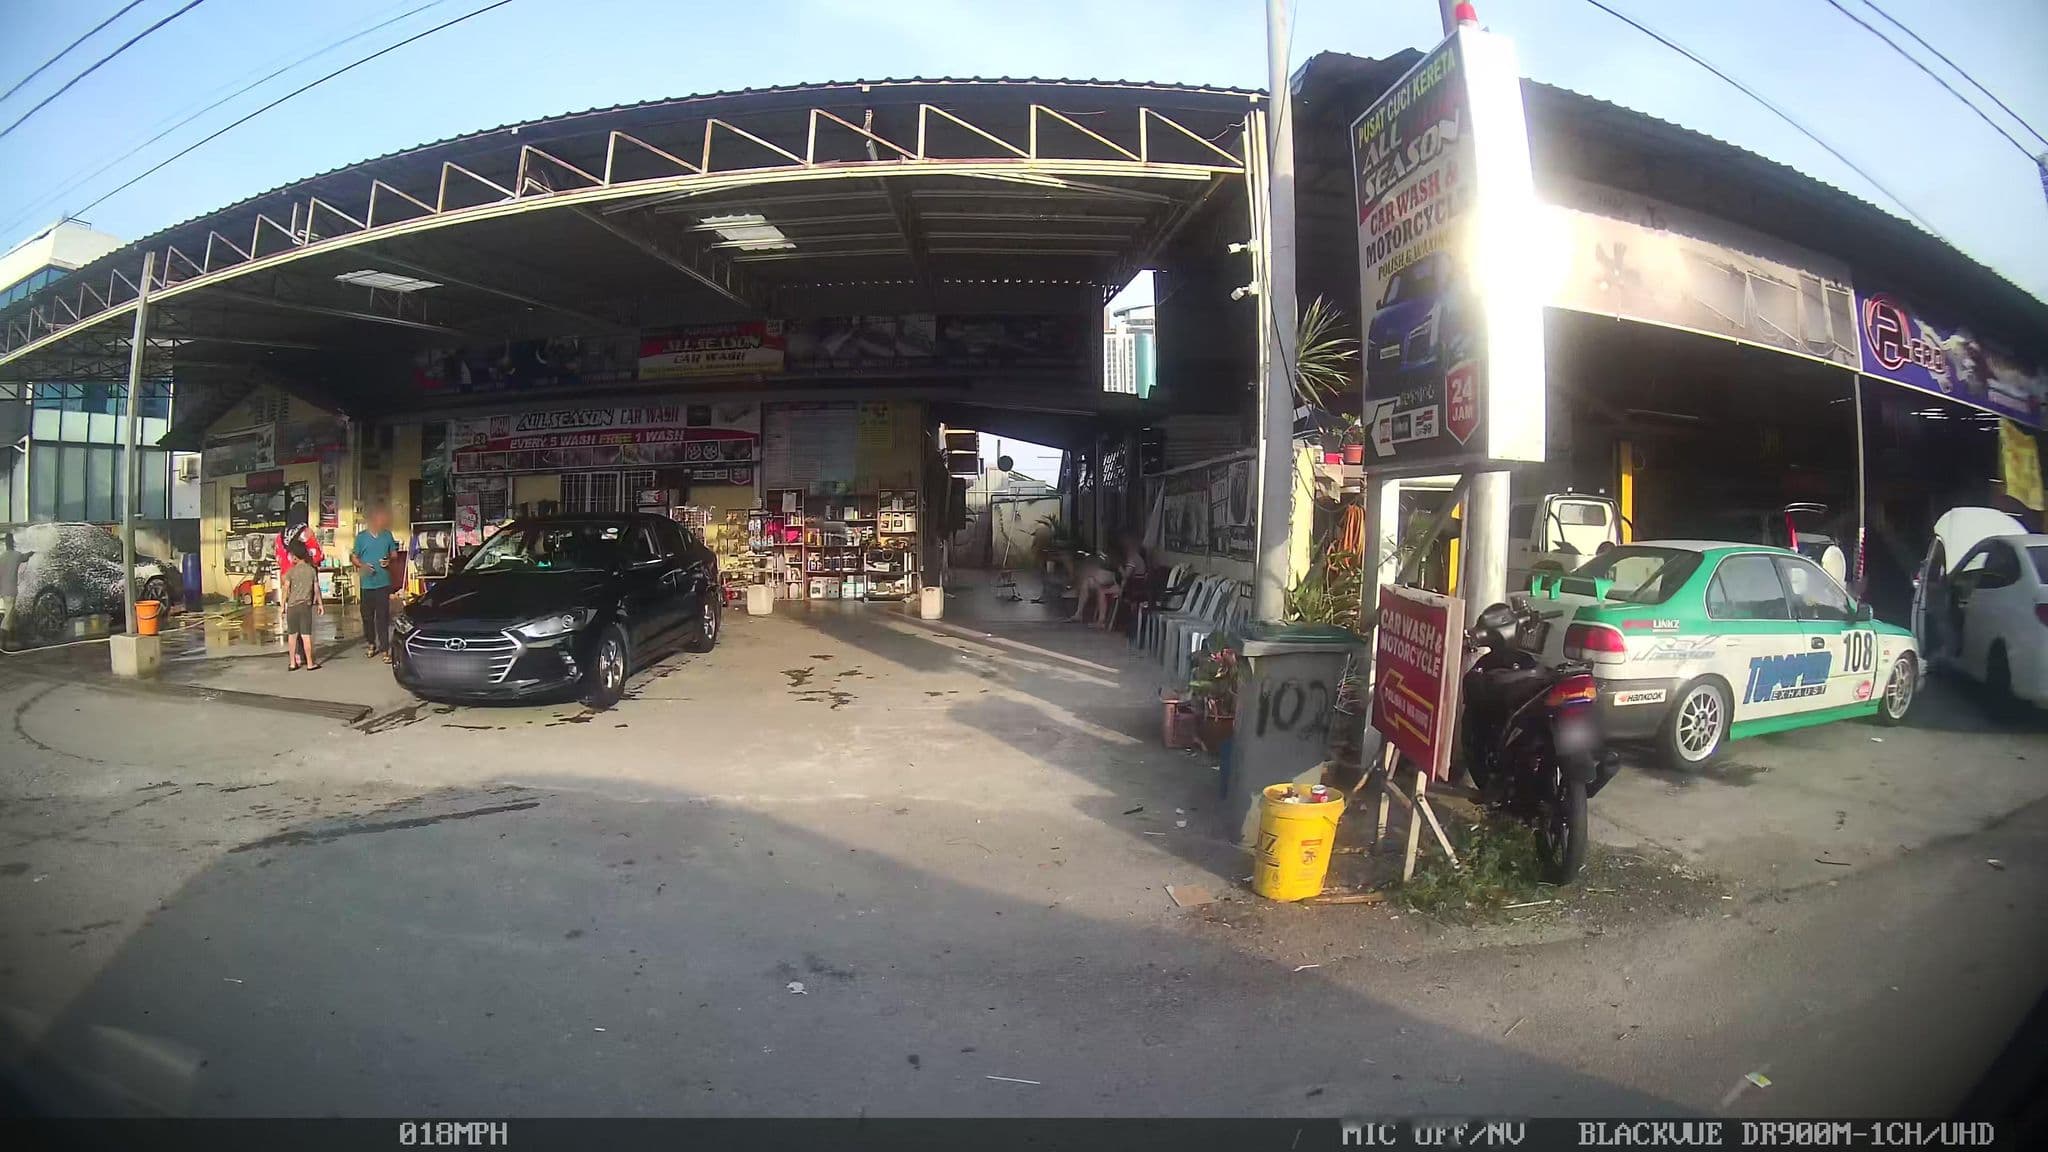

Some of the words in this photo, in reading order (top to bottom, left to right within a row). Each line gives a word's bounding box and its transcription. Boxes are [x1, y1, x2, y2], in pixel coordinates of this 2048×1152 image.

[1358, 108, 1385, 148] PUSAT
[1387, 87, 1411, 121] CUCI
[1414, 48, 1456, 101] KERETA
[1363, 120, 1403, 175] ALL
[1364, 108, 1460, 205] SEASON
[1370, 197, 1395, 236] CAR
[1395, 169, 1440, 217] WASH
[1452, 376, 1473, 403] 24
[1451, 405, 1473, 422] JAM
[510, 437, 548, 451] EVERY
[560, 434, 596, 447] WASH
[646, 429, 685, 442] WASH
[1381, 608, 1402, 636] CAR
[1402, 614, 1436, 651] WASH
[1434, 633, 1443, 654] &
[1843, 631, 1873, 672] 108
[1380, 630, 1441, 679] MOTORCYCLE
[1772, 685, 1827, 700] EXHAUST
